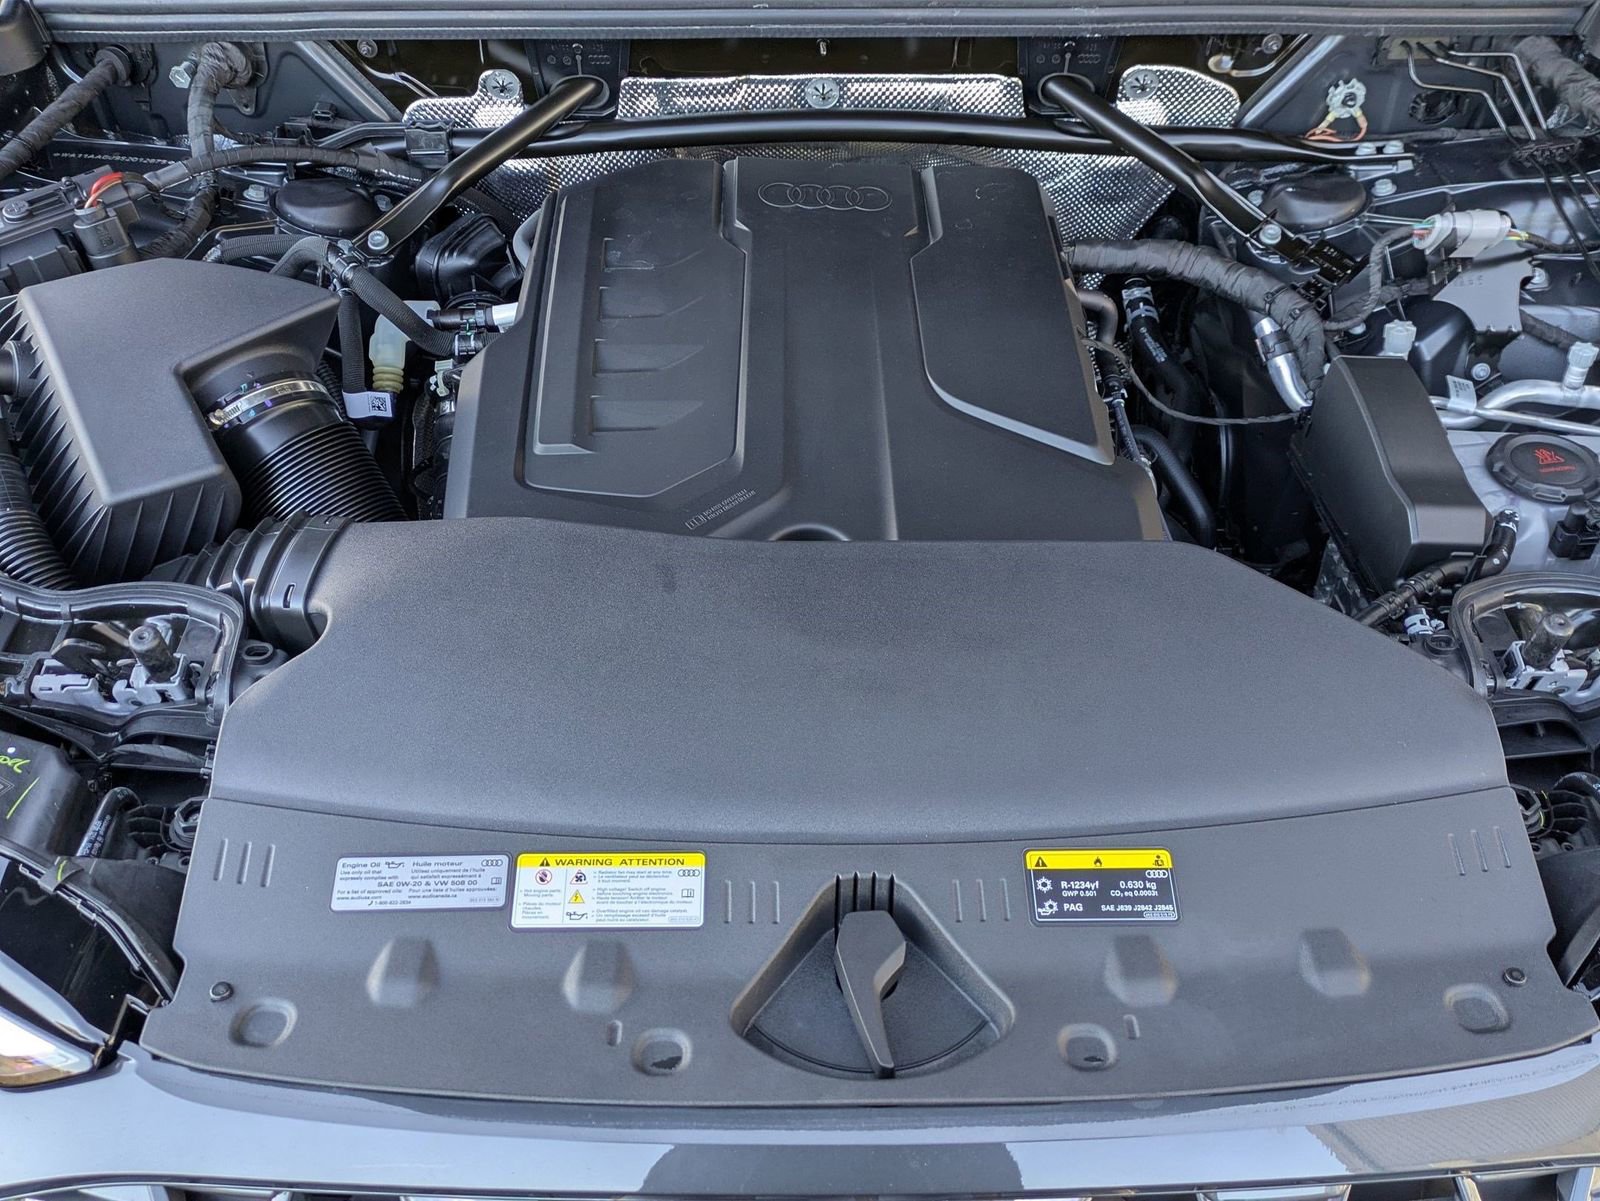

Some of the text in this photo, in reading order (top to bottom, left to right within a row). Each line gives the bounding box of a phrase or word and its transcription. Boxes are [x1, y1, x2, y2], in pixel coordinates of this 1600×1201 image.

[1061, 880, 1157, 890] R-1234yf 0.630 kg
[1064, 903, 1083, 912] PAG
